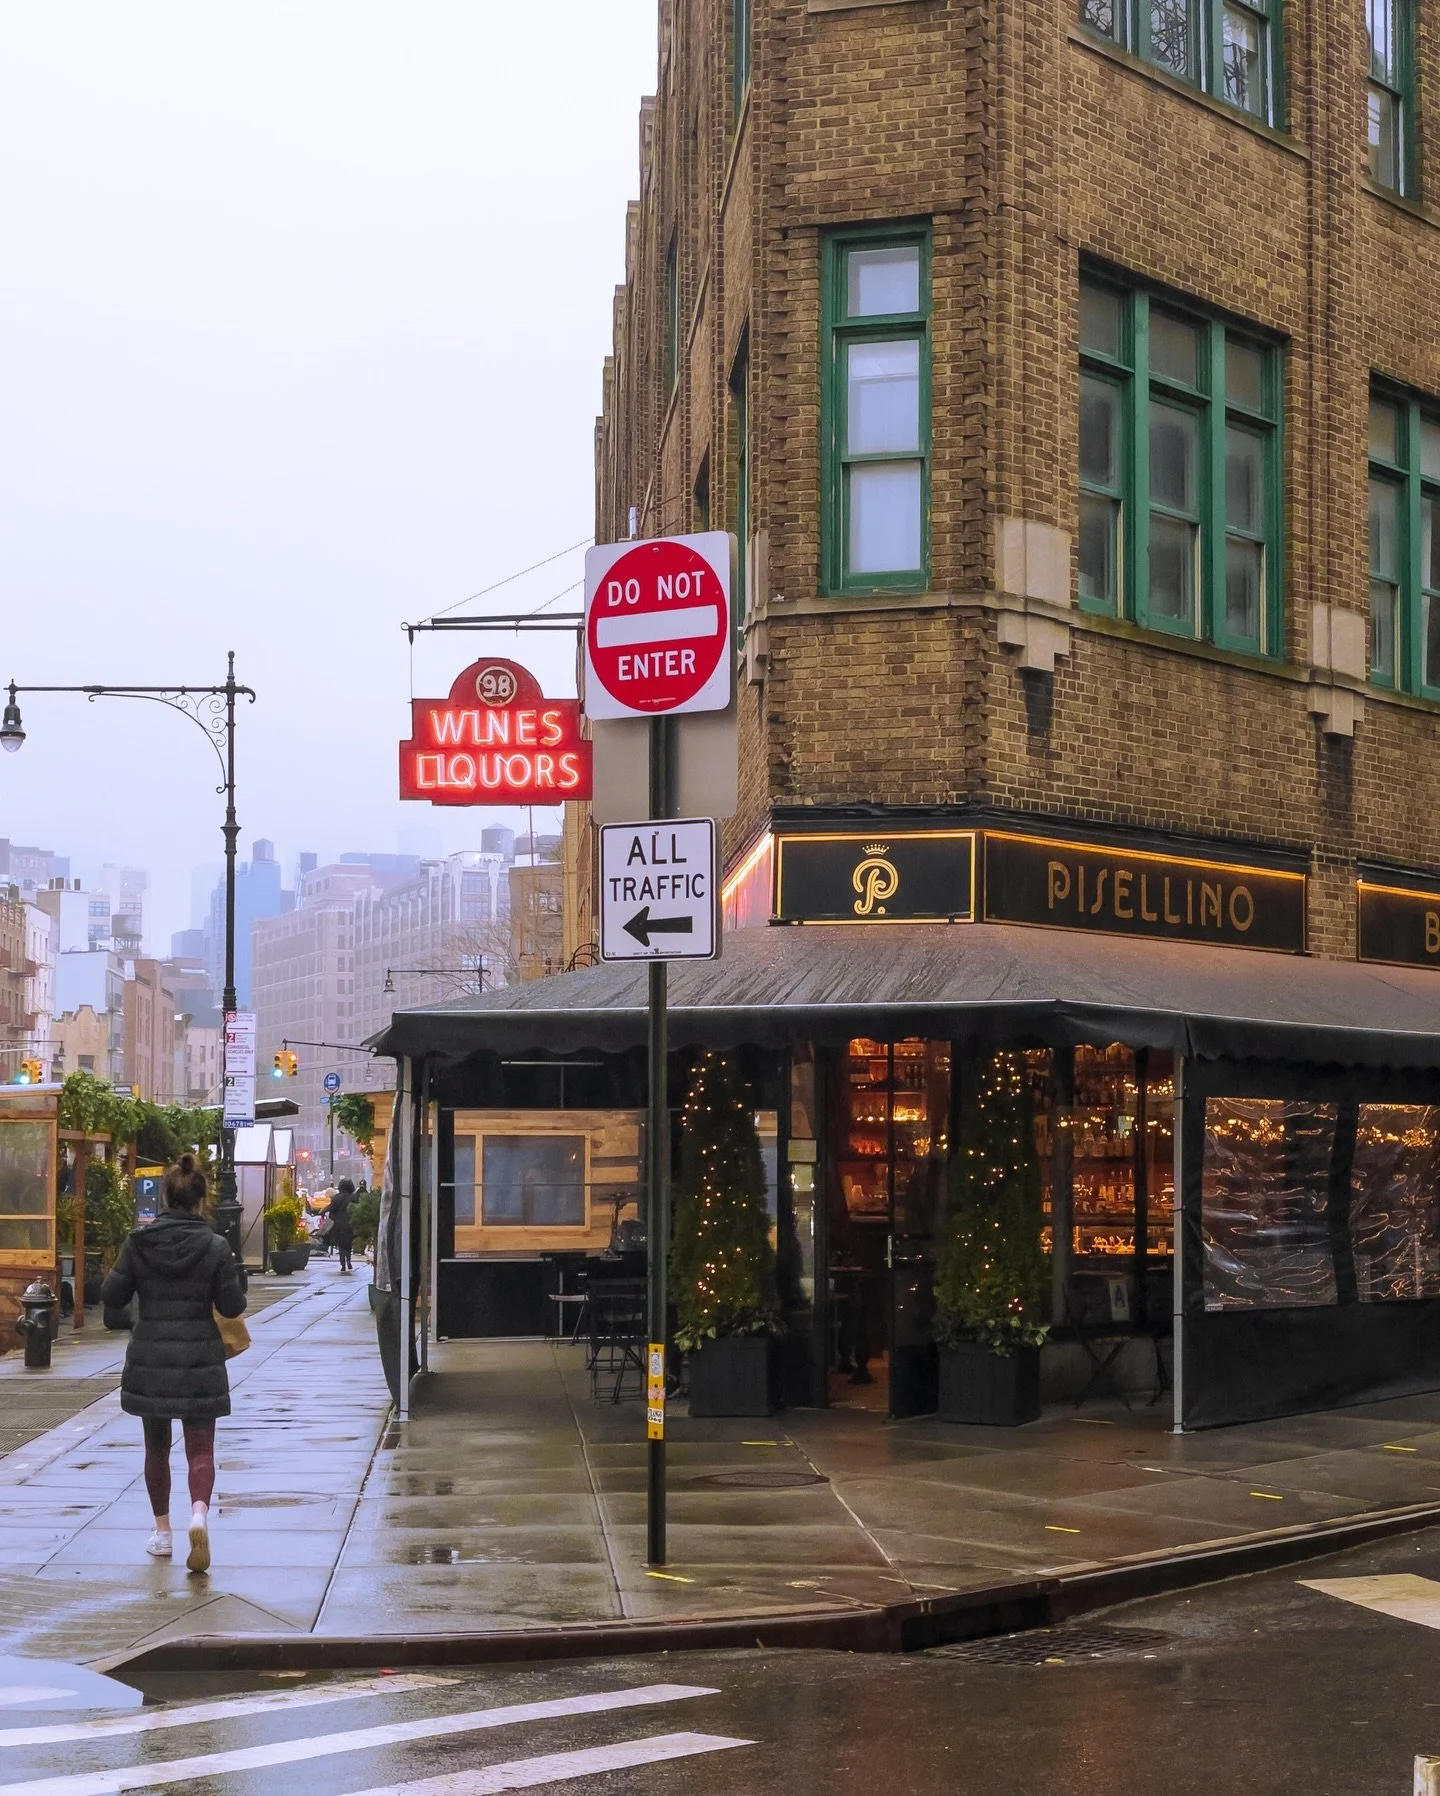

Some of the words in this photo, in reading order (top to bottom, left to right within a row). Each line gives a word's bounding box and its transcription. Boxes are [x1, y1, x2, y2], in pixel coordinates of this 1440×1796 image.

[608, 578, 640, 607] DO
[658, 570, 705, 601] NOT
[618, 649, 696, 681] ENTER
[482, 674, 512, 698] 98
[430, 709, 563, 747] WINES
[416, 753, 579, 790] LIQUORS
[627, 833, 687, 866] ALL
[609, 873, 705, 902] TRAFFIC
[1047, 860, 1255, 932] PISELLINO
[228, 1033, 234, 1042] 2
[227, 1077, 234, 1086] 2
[143, 1179, 154, 1194] P
